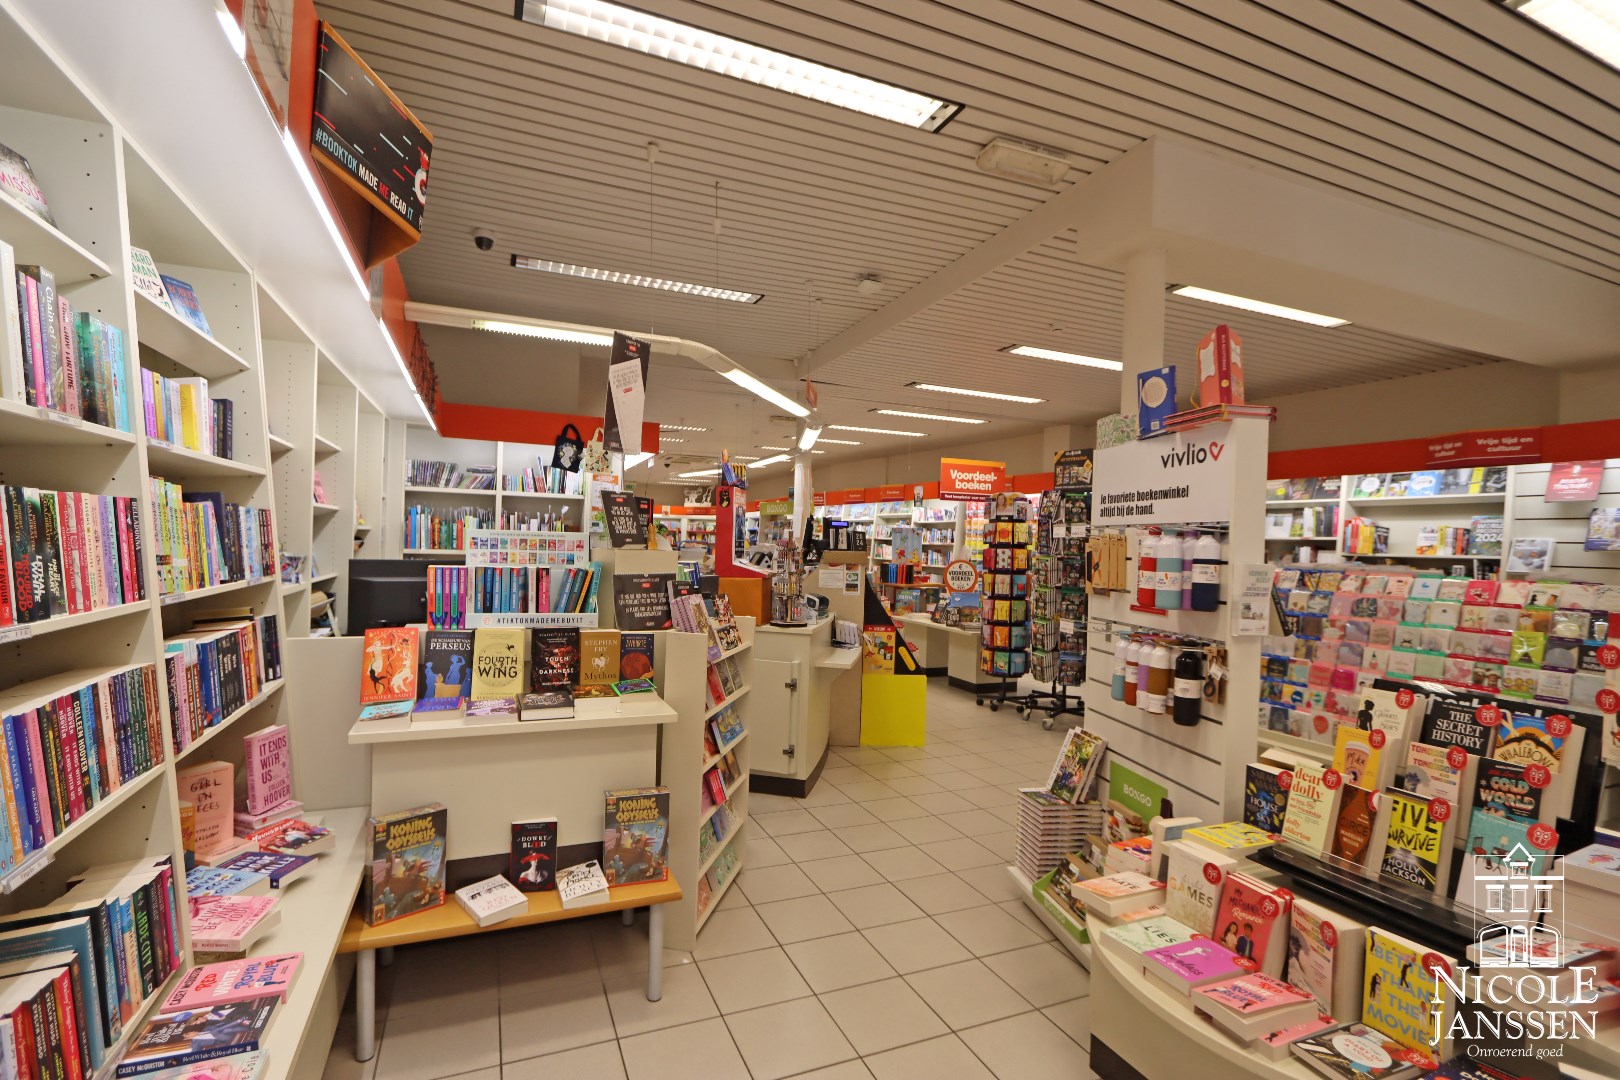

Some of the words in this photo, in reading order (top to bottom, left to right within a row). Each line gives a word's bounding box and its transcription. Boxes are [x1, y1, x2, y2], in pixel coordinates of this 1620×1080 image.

[315, 127, 358, 173] #BOOKTOK
[358, 163, 379, 192] MADE
[378, 181, 389, 200] ME
[389, 191, 407, 215] READ
[407, 207, 414, 221] IT
[1476, 438, 1500, 446] Vrije
[1160, 442, 1207, 469] vivlio
[950, 468, 998, 482] Voordeel-
[955, 479, 992, 491] boeken
[1100, 494, 1107, 505] Je
[1107, 491, 1136, 504] favoriete
[1136, 485, 1190, 502] boekenwinkel
[766, 504, 788, 513] BONGO
[1100, 505, 1116, 518] altijd
[1116, 505, 1125, 517] bij
[1125, 504, 1134, 516] de
[1135, 503, 1155, 516] hand.
[131, 501, 142, 550] BELLADONNA
[22, 553, 34, 609] TROUBLED
[31, 560, 41, 604] WHITE
[36, 555, 46, 595] LETHAL
[47, 562, 56, 594] HEART
[0, 567, 9, 605] FAVOUR
[15, 560, 27, 613] BLOOD
[430, 642, 471, 651] PERSEUS
[478, 656, 518, 665] FOURTH
[477, 665, 518, 679] WING
[584, 672, 617, 681] Mythos
[58, 710, 67, 739] HOOVER
[66, 706, 75, 735] HOOVER
[73, 700, 84, 738] COLLEEN
[1380, 722, 1399, 731] Stars
[1449, 710, 1473, 724] THE
[4, 723, 16, 752] DAISY
[1435, 719, 1483, 737] SECRET
[71, 741, 77, 749] IT
[258, 744, 268, 757] IT
[267, 735, 287, 751] ENDS
[1431, 730, 1485, 749] HISTORY
[77, 738, 88, 773] HOOVER
[259, 753, 280, 770] WITH
[9, 754, 22, 790] HAITES
[67, 773, 75, 791] WITH
[74, 769, 82, 786] WITH
[261, 769, 273, 785] US
[1295, 767, 1323, 786] dear
[77, 786, 83, 796] US
[190, 778, 222, 793] GIRL
[263, 784, 291, 807] HOOVER
[1123, 783, 1152, 807] BONGO
[1292, 781, 1324, 800] dolly
[70, 791, 77, 801] US
[618, 796, 657, 812] KONING
[1250, 796, 1279, 814] HOUSE
[1479, 787, 1536, 811] WORLD
[615, 808, 660, 822] ODYSSEUS
[1256, 814, 1271, 824] SKY
[1392, 799, 1438, 834] FIVE
[389, 816, 433, 839] KONING
[1340, 817, 1370, 836] CIRCE
[1340, 829, 1364, 843] MADELINE
[385, 828, 437, 851] ODYSSEUS
[1387, 825, 1437, 852] SURVIVE
[1381, 863, 1427, 886] JACKSON
[1387, 856, 1421, 875] HOLLY
[1107, 876, 1139, 889] HATE
[1169, 875, 1214, 908] GAMES
[136, 909, 150, 942] JADE
[1143, 925, 1178, 944] LIES
[139, 943, 154, 969] CITY
[194, 973, 218, 992] RED
[212, 968, 241, 998] WHITE
[233, 961, 262, 991] ROYAL
[1380, 967, 1431, 1003] THAN
[1233, 980, 1275, 997] WHITE
[43, 992, 55, 1023] EVELYN
[1386, 991, 1420, 1020] THE
[30, 1004, 42, 1034] EVELYN
[47, 1022, 58, 1047] HUGO
[35, 1034, 45, 1059] HUGO
[1344, 1037, 1370, 1057] DIARY
[1352, 1046, 1374, 1062] VOID
[117, 1065, 136, 1075] CASEY
[136, 1061, 165, 1072] McQUISTON
